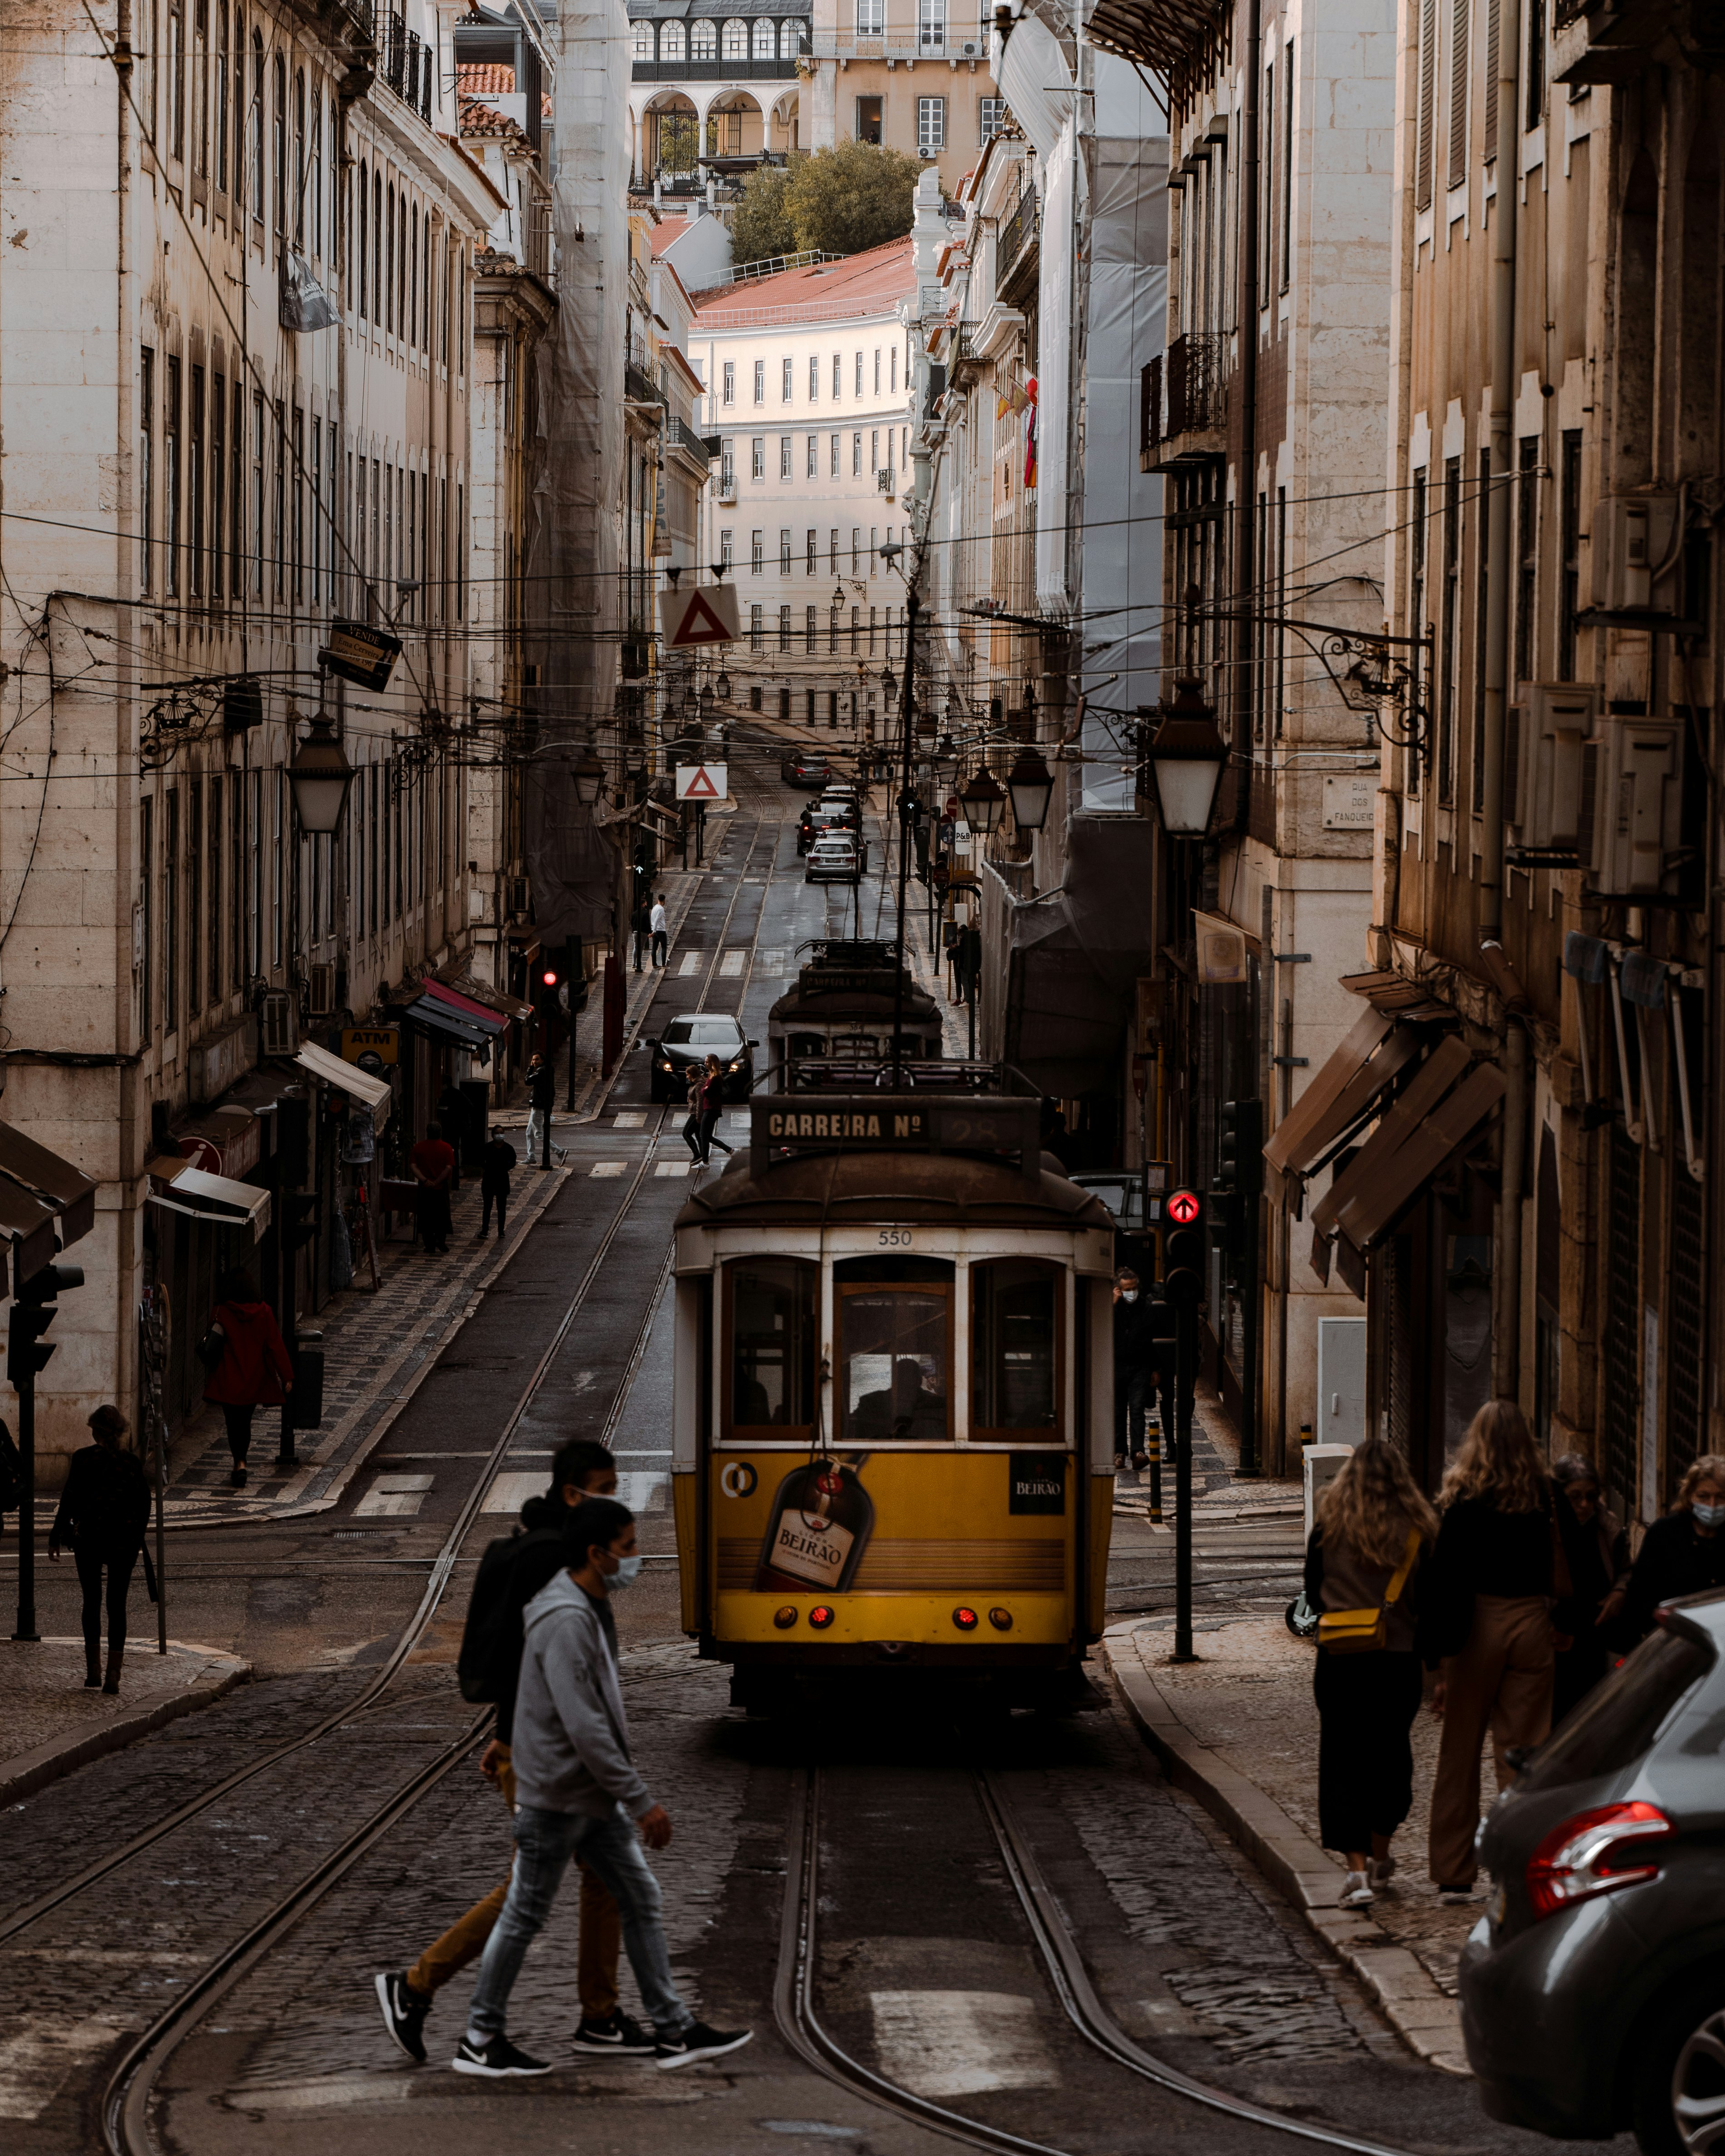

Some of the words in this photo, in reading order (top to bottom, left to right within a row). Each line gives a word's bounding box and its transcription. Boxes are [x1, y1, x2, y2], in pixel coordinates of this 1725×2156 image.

[349, 625, 380, 646] VENDE
[338, 637, 352, 648] Ema
[354, 643, 379, 660] Cerveira
[1352, 783, 1367, 791] RUA
[1352, 798, 1368, 806] DOS
[351, 1032, 390, 1044] ATM
[769, 1114, 881, 1137] CARREIRA
[894, 1114, 922, 1137] Nº
[878, 1230, 913, 1246] 550
[1016, 1480, 1061, 1496] BEIRÃO
[779, 1528, 841, 1565] BEIRÃO
